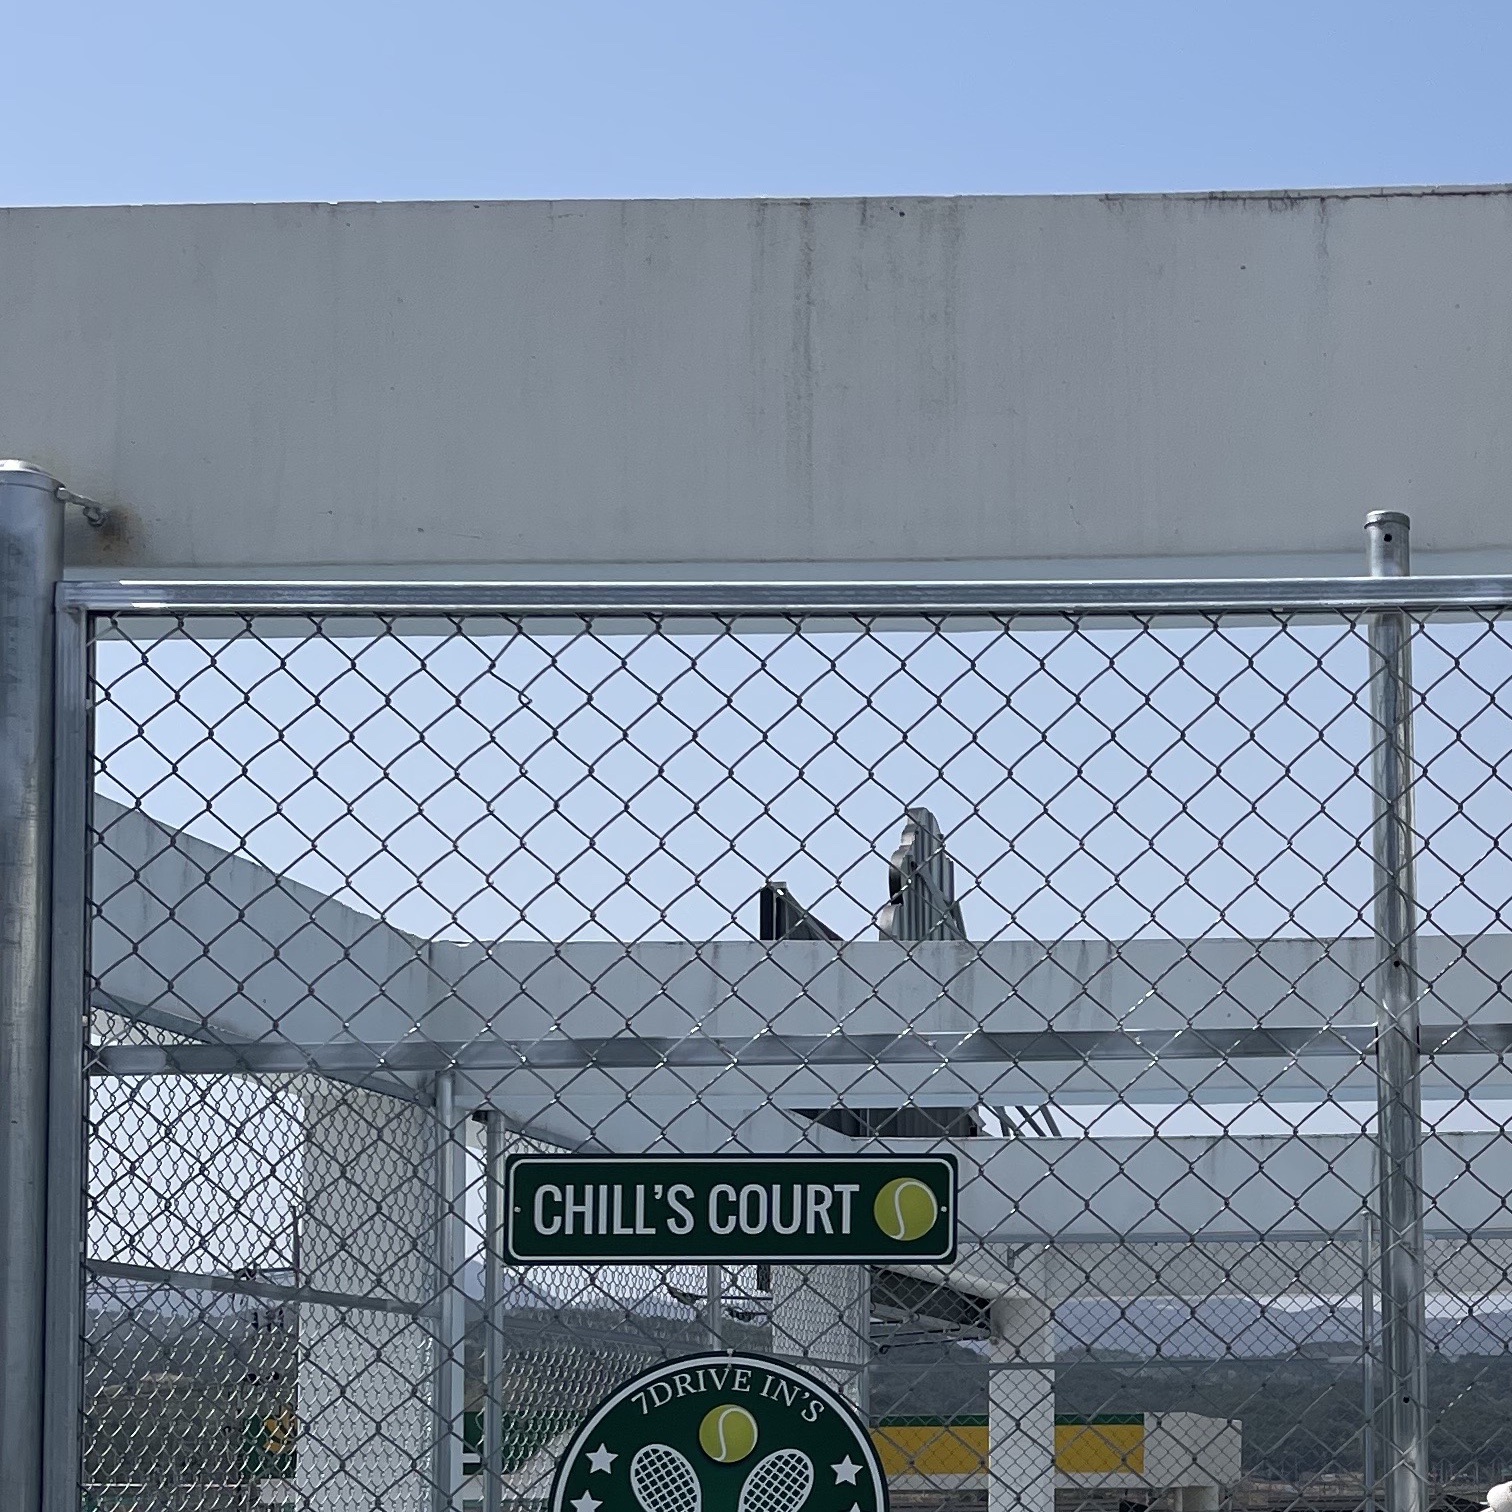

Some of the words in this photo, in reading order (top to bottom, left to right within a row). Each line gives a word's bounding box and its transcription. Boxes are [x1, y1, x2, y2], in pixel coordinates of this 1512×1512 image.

[533, 1184, 695, 1236] CHILL'S
[708, 1184, 860, 1235] COURT
[631, 1368, 752, 1415] 7DRIVE
[759, 1375, 825, 1423] IN'S
